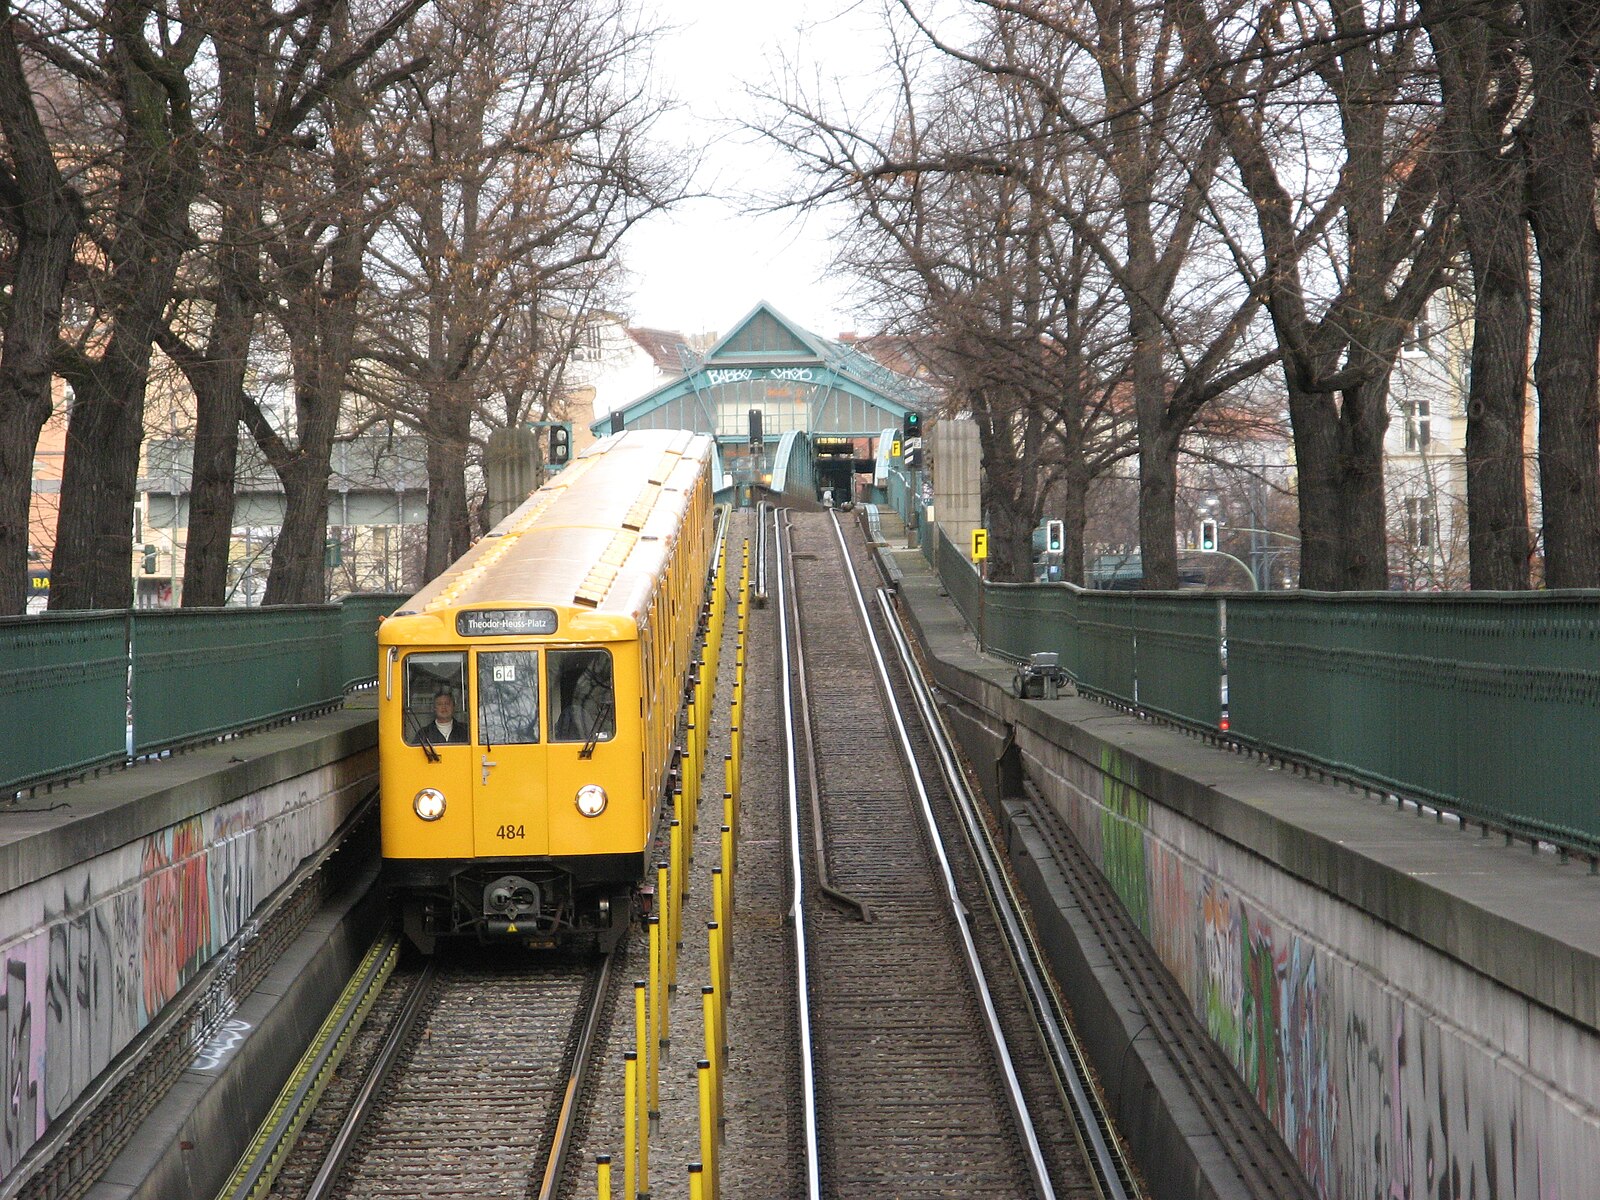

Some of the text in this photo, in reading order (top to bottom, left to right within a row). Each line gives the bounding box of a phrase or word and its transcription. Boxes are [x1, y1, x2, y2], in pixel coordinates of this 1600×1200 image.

[975, 533, 985, 554] F
[468, 619, 547, 629] Theodor-Heuss-Platz
[495, 668, 514, 680] 64
[496, 824, 526, 840] 484
